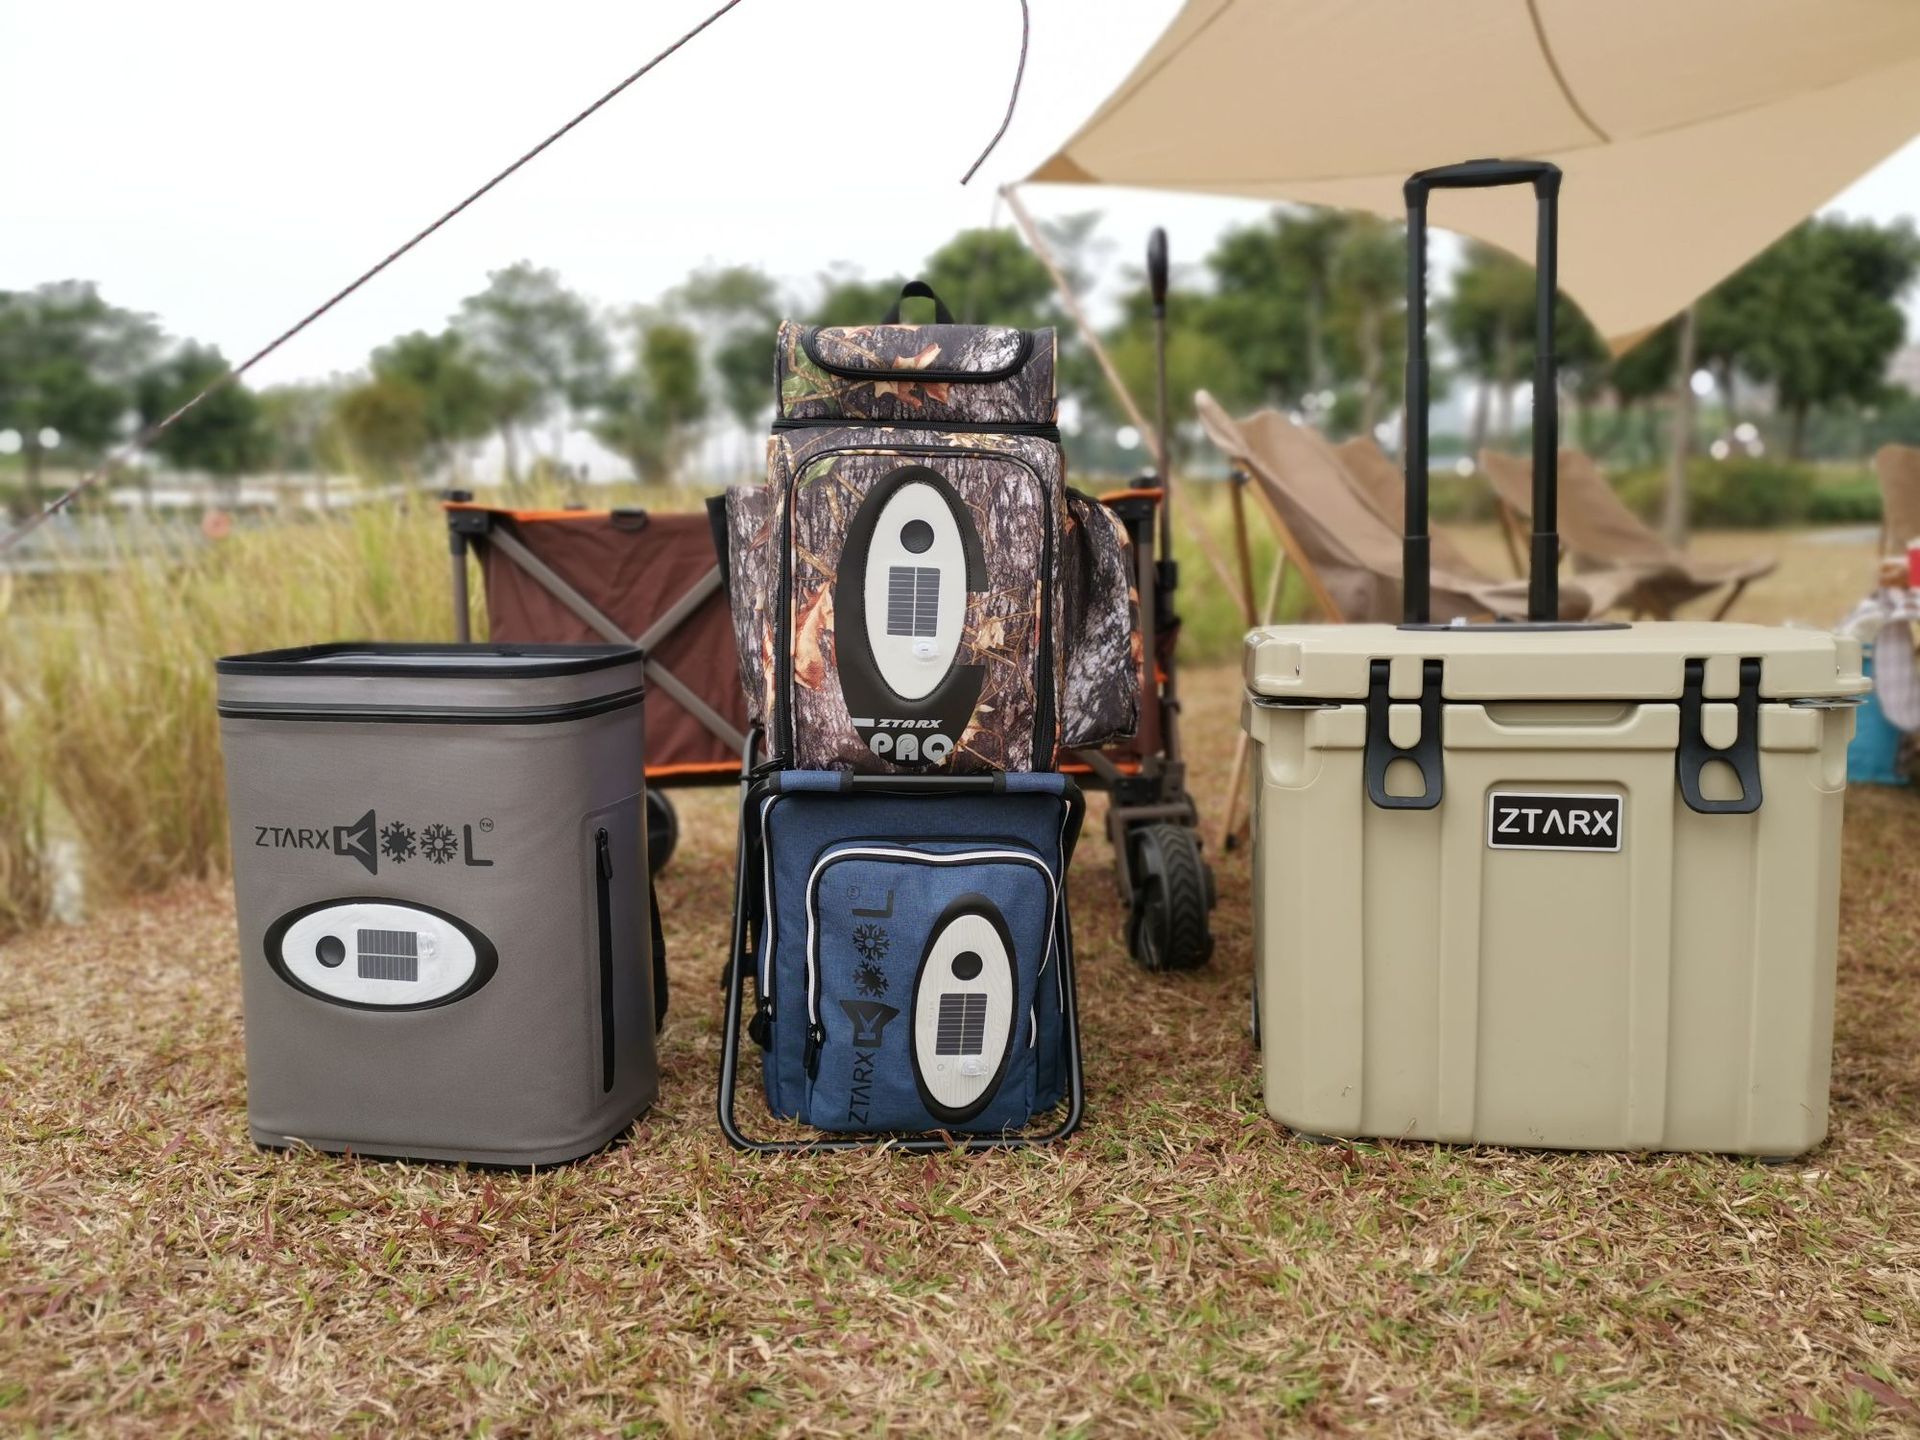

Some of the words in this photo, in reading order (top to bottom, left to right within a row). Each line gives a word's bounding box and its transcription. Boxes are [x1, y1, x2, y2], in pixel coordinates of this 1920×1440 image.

[877, 718, 943, 729] ZTARX
[1497, 807, 1614, 837] ZTARX
[255, 826, 330, 850] ZTARX
[848, 1050, 875, 1125] ZTARX
